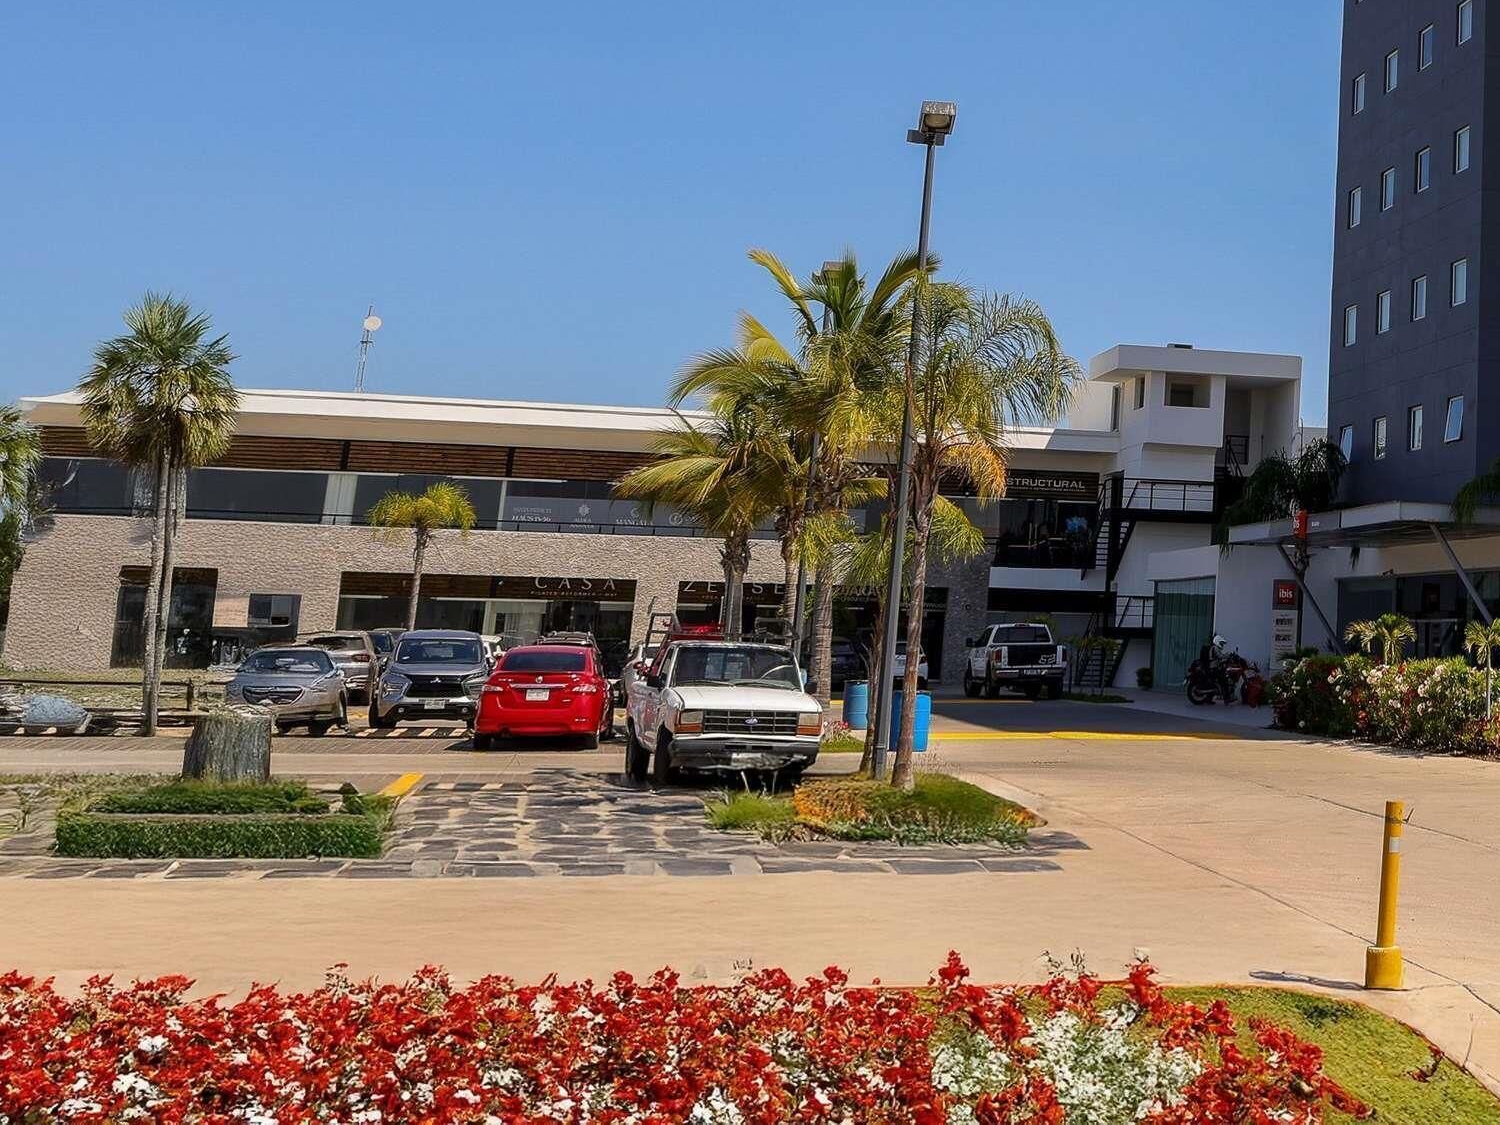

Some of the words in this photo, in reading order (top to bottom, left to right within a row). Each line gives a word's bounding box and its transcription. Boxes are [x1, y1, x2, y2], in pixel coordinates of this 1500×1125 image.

[1007, 477, 1085, 489] STRUCTURAL
[535, 577, 615, 590] CASA
[1279, 589, 1293, 598] ibis
